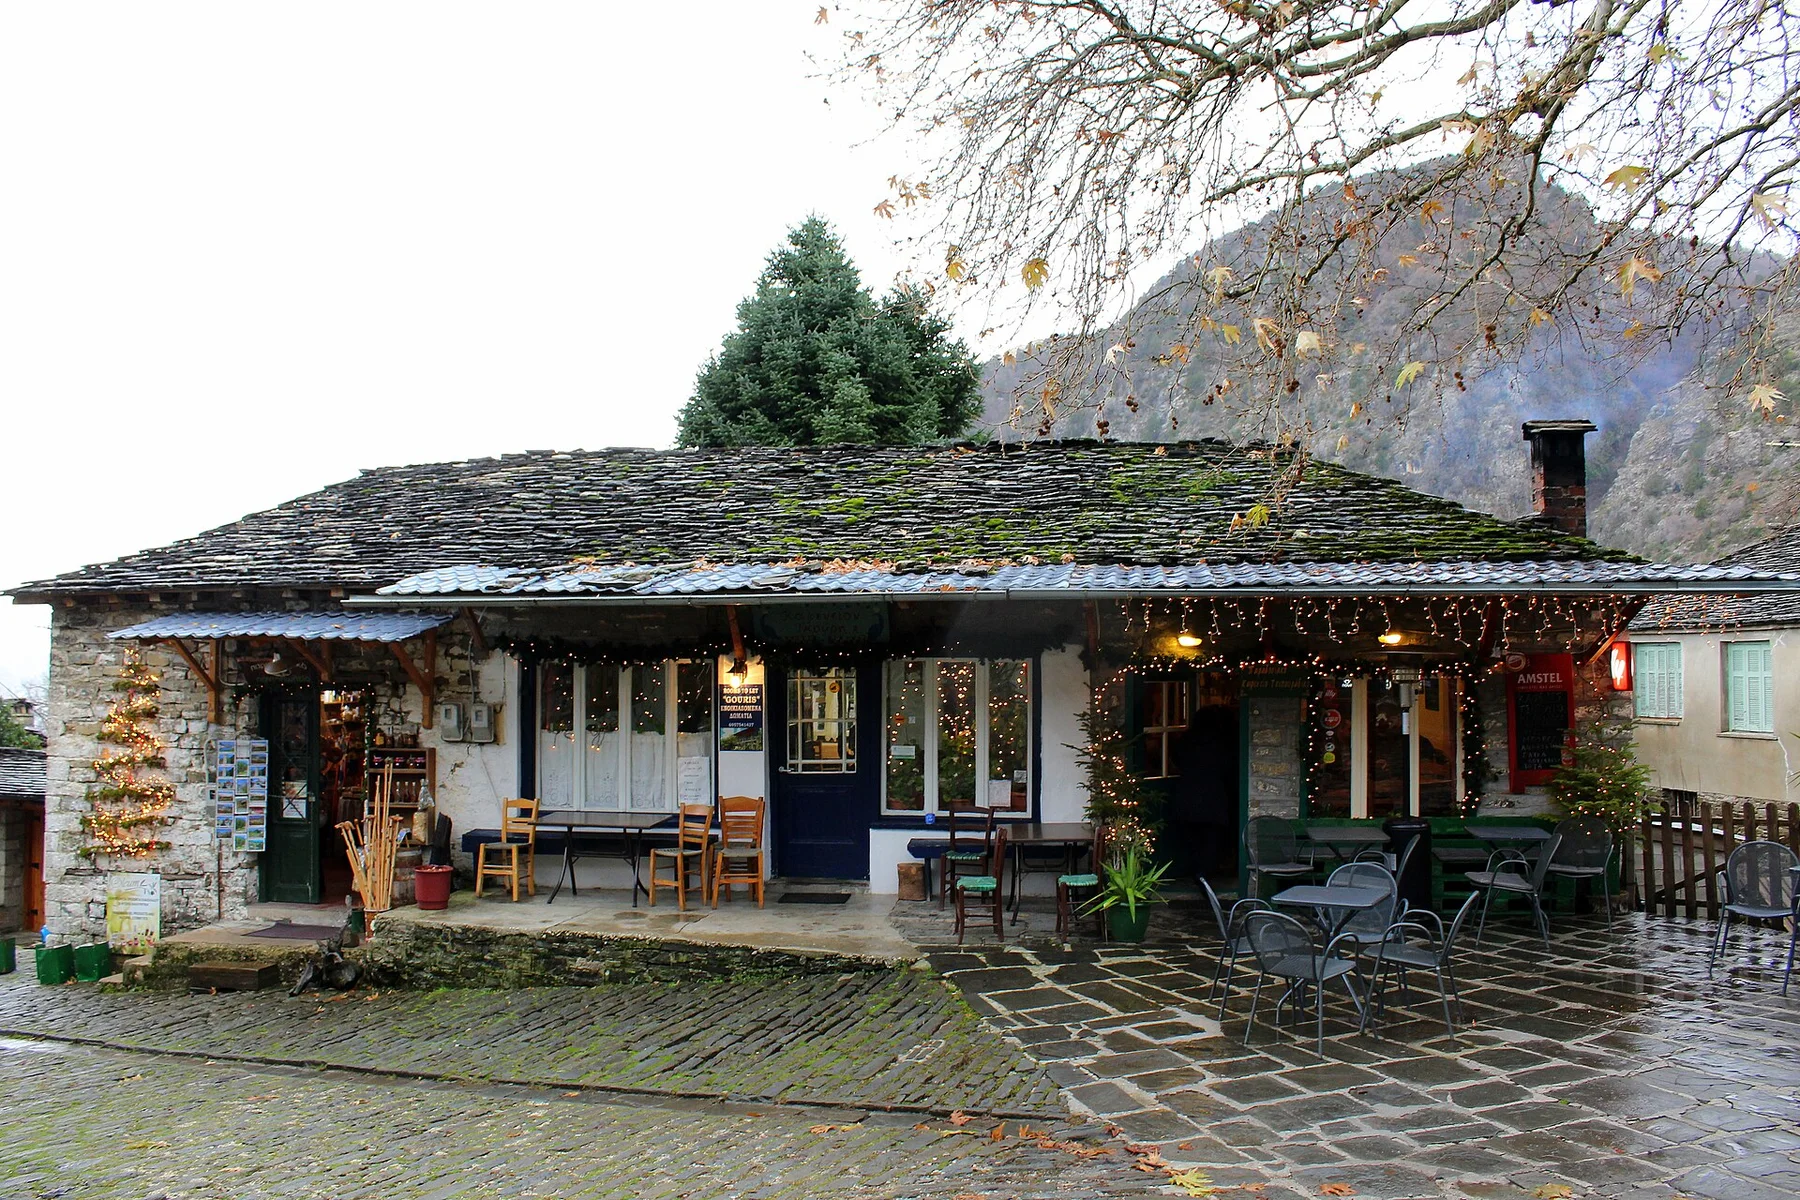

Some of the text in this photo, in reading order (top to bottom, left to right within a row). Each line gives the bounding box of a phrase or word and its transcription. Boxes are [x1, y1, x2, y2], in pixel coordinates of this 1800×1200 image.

[1517, 672, 1563, 684] AMSTEL
[741, 687, 749, 695] TO
[749, 687, 759, 695] LET
[723, 695, 760, 704] "GOURIS"
